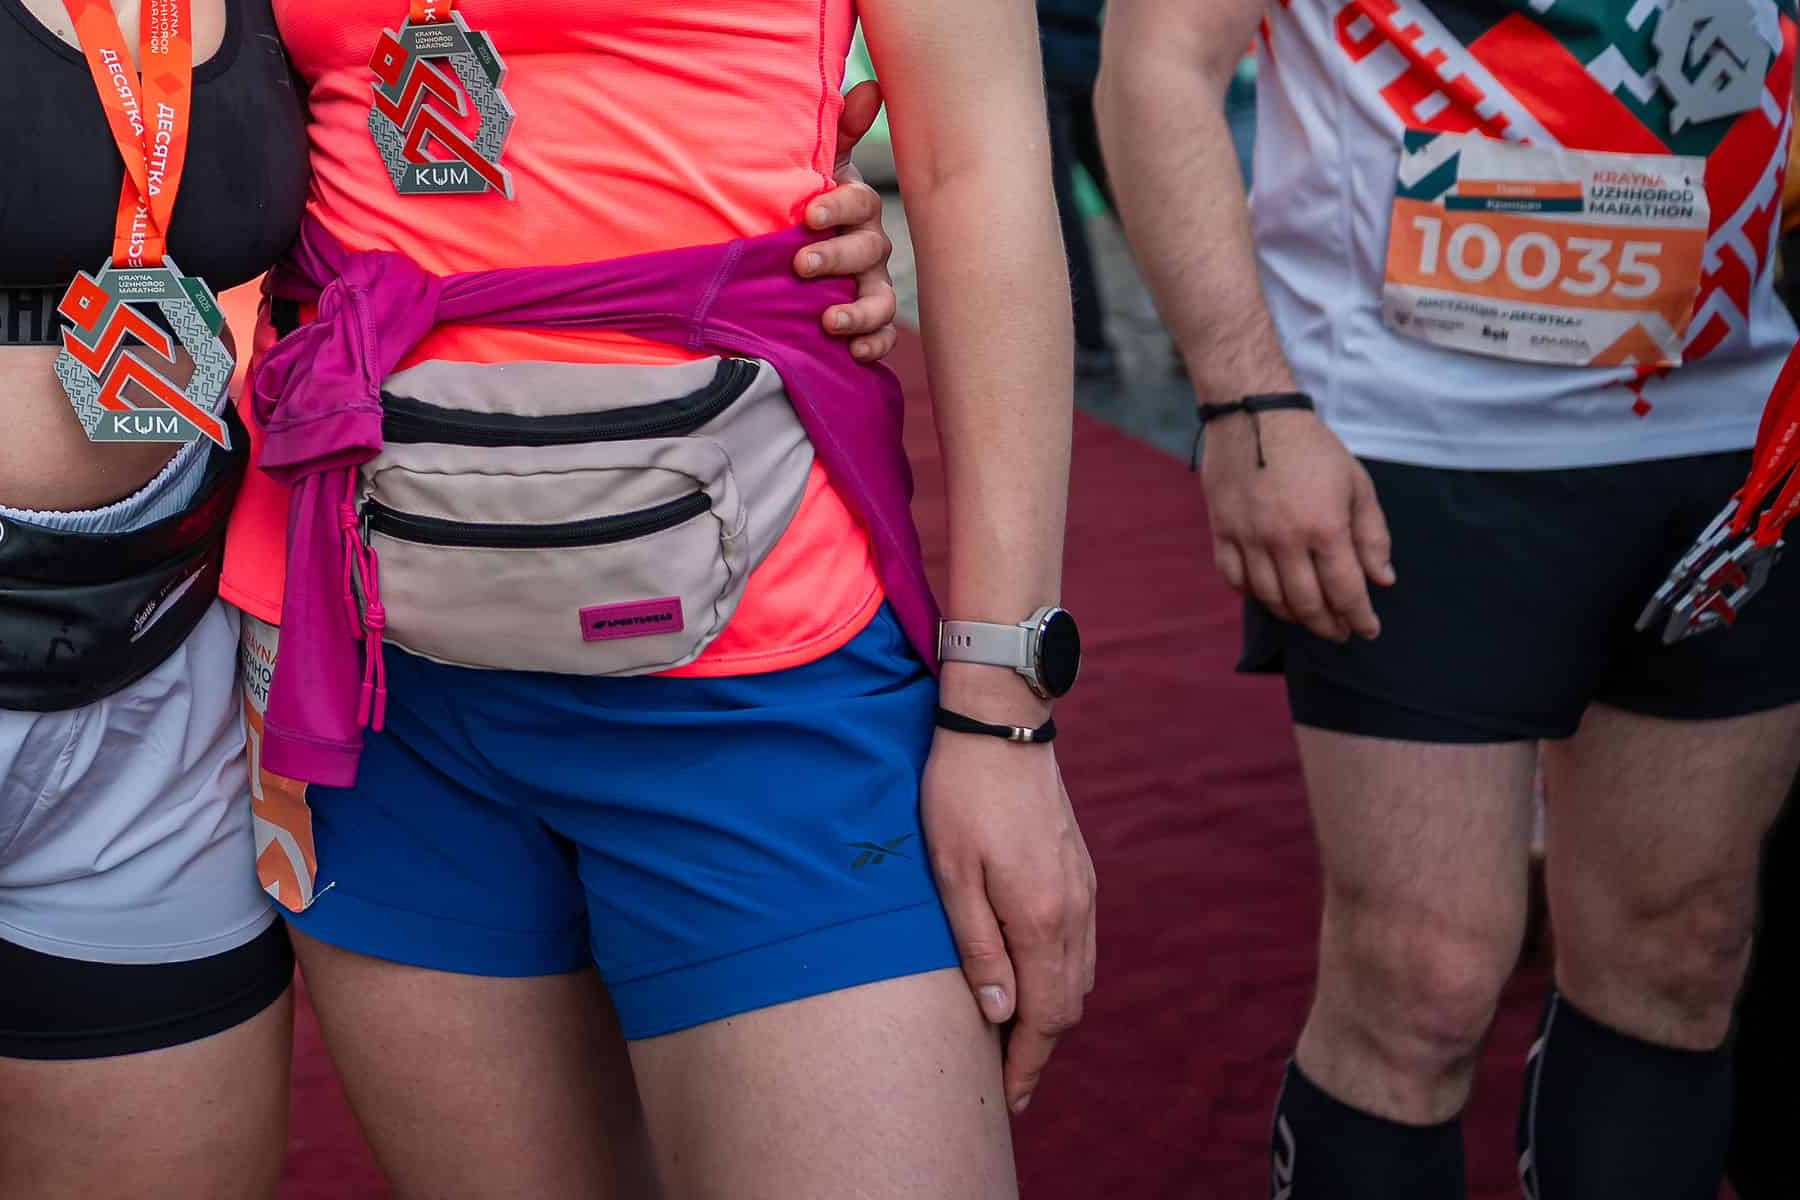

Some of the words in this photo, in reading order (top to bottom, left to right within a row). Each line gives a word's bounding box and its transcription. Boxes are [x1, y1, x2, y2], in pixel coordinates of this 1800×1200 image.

[101, 48, 144, 137] ДЕСЯТКА
[148, 102, 176, 197] ДЕСЯТКА
[415, 167, 469, 186] KUM
[1413, 215, 1664, 299] 10035
[113, 415, 179, 435] KUM
